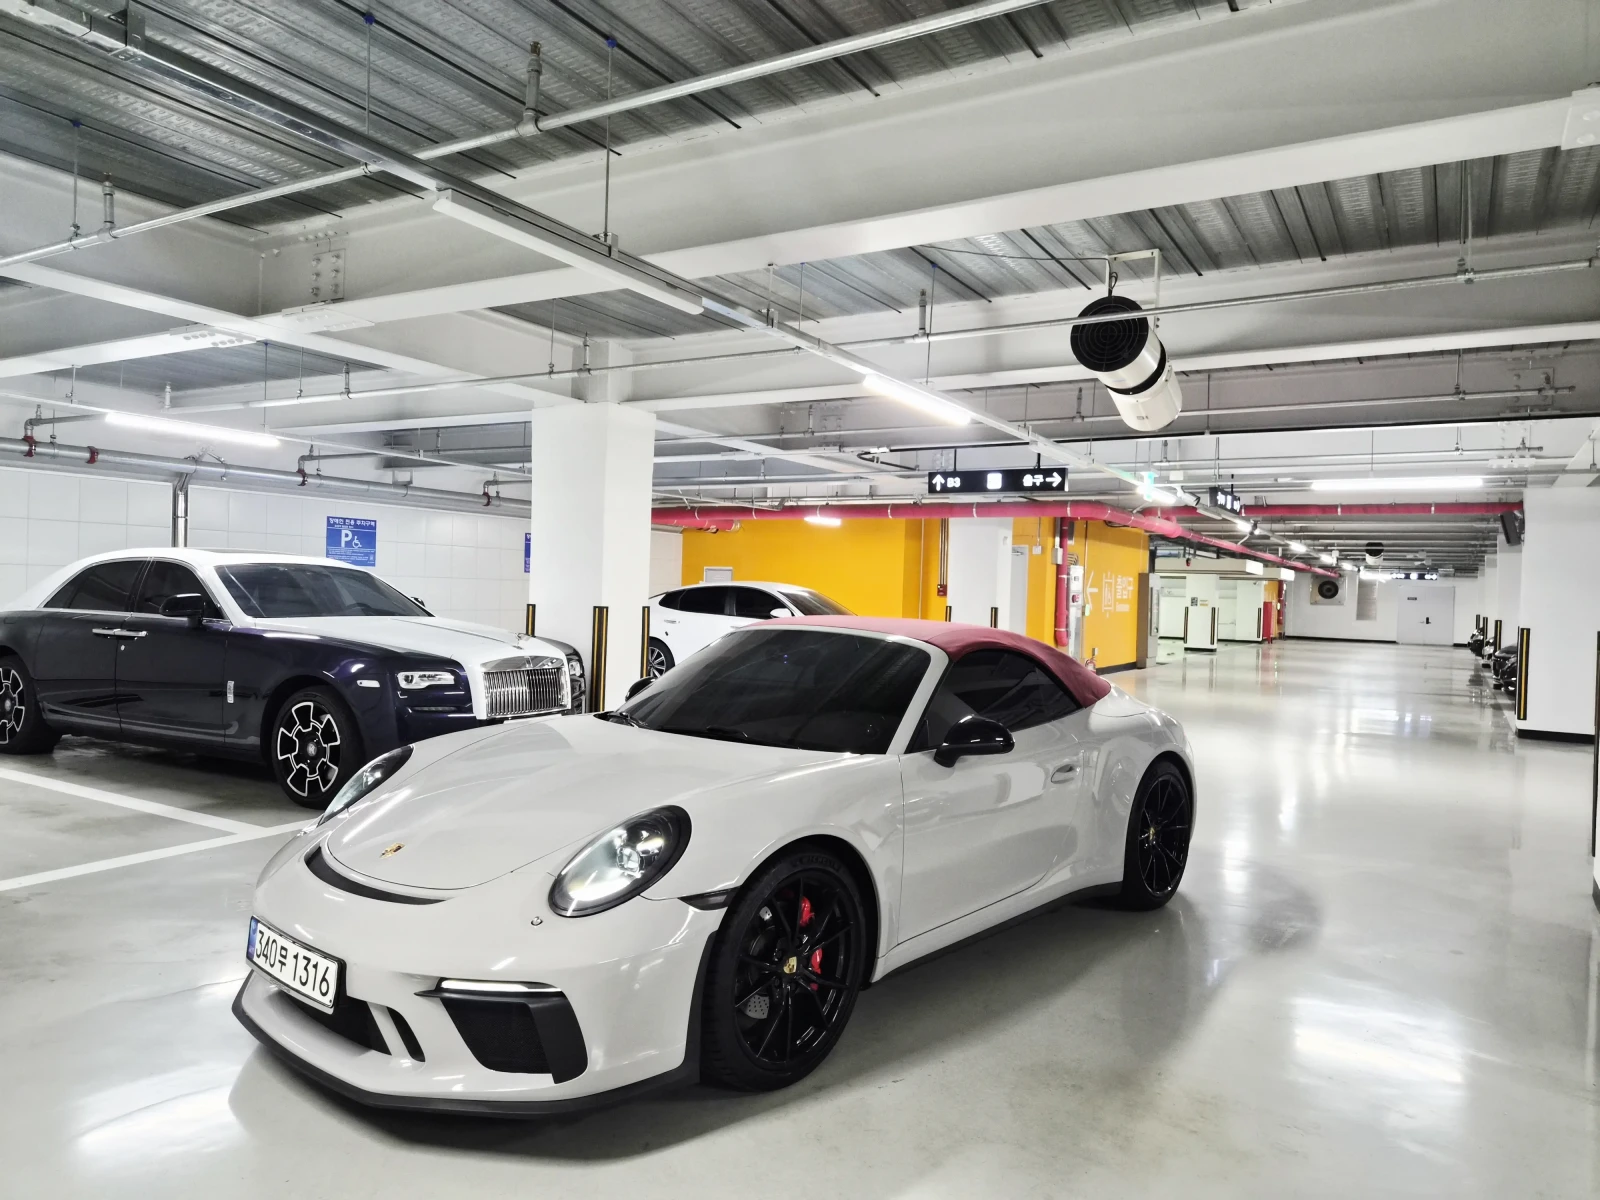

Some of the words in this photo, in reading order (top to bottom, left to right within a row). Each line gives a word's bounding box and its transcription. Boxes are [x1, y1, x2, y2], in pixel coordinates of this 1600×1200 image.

[341, 529, 353, 548] P
[255, 929, 289, 973] 340무
[292, 951, 330, 997] 1316
